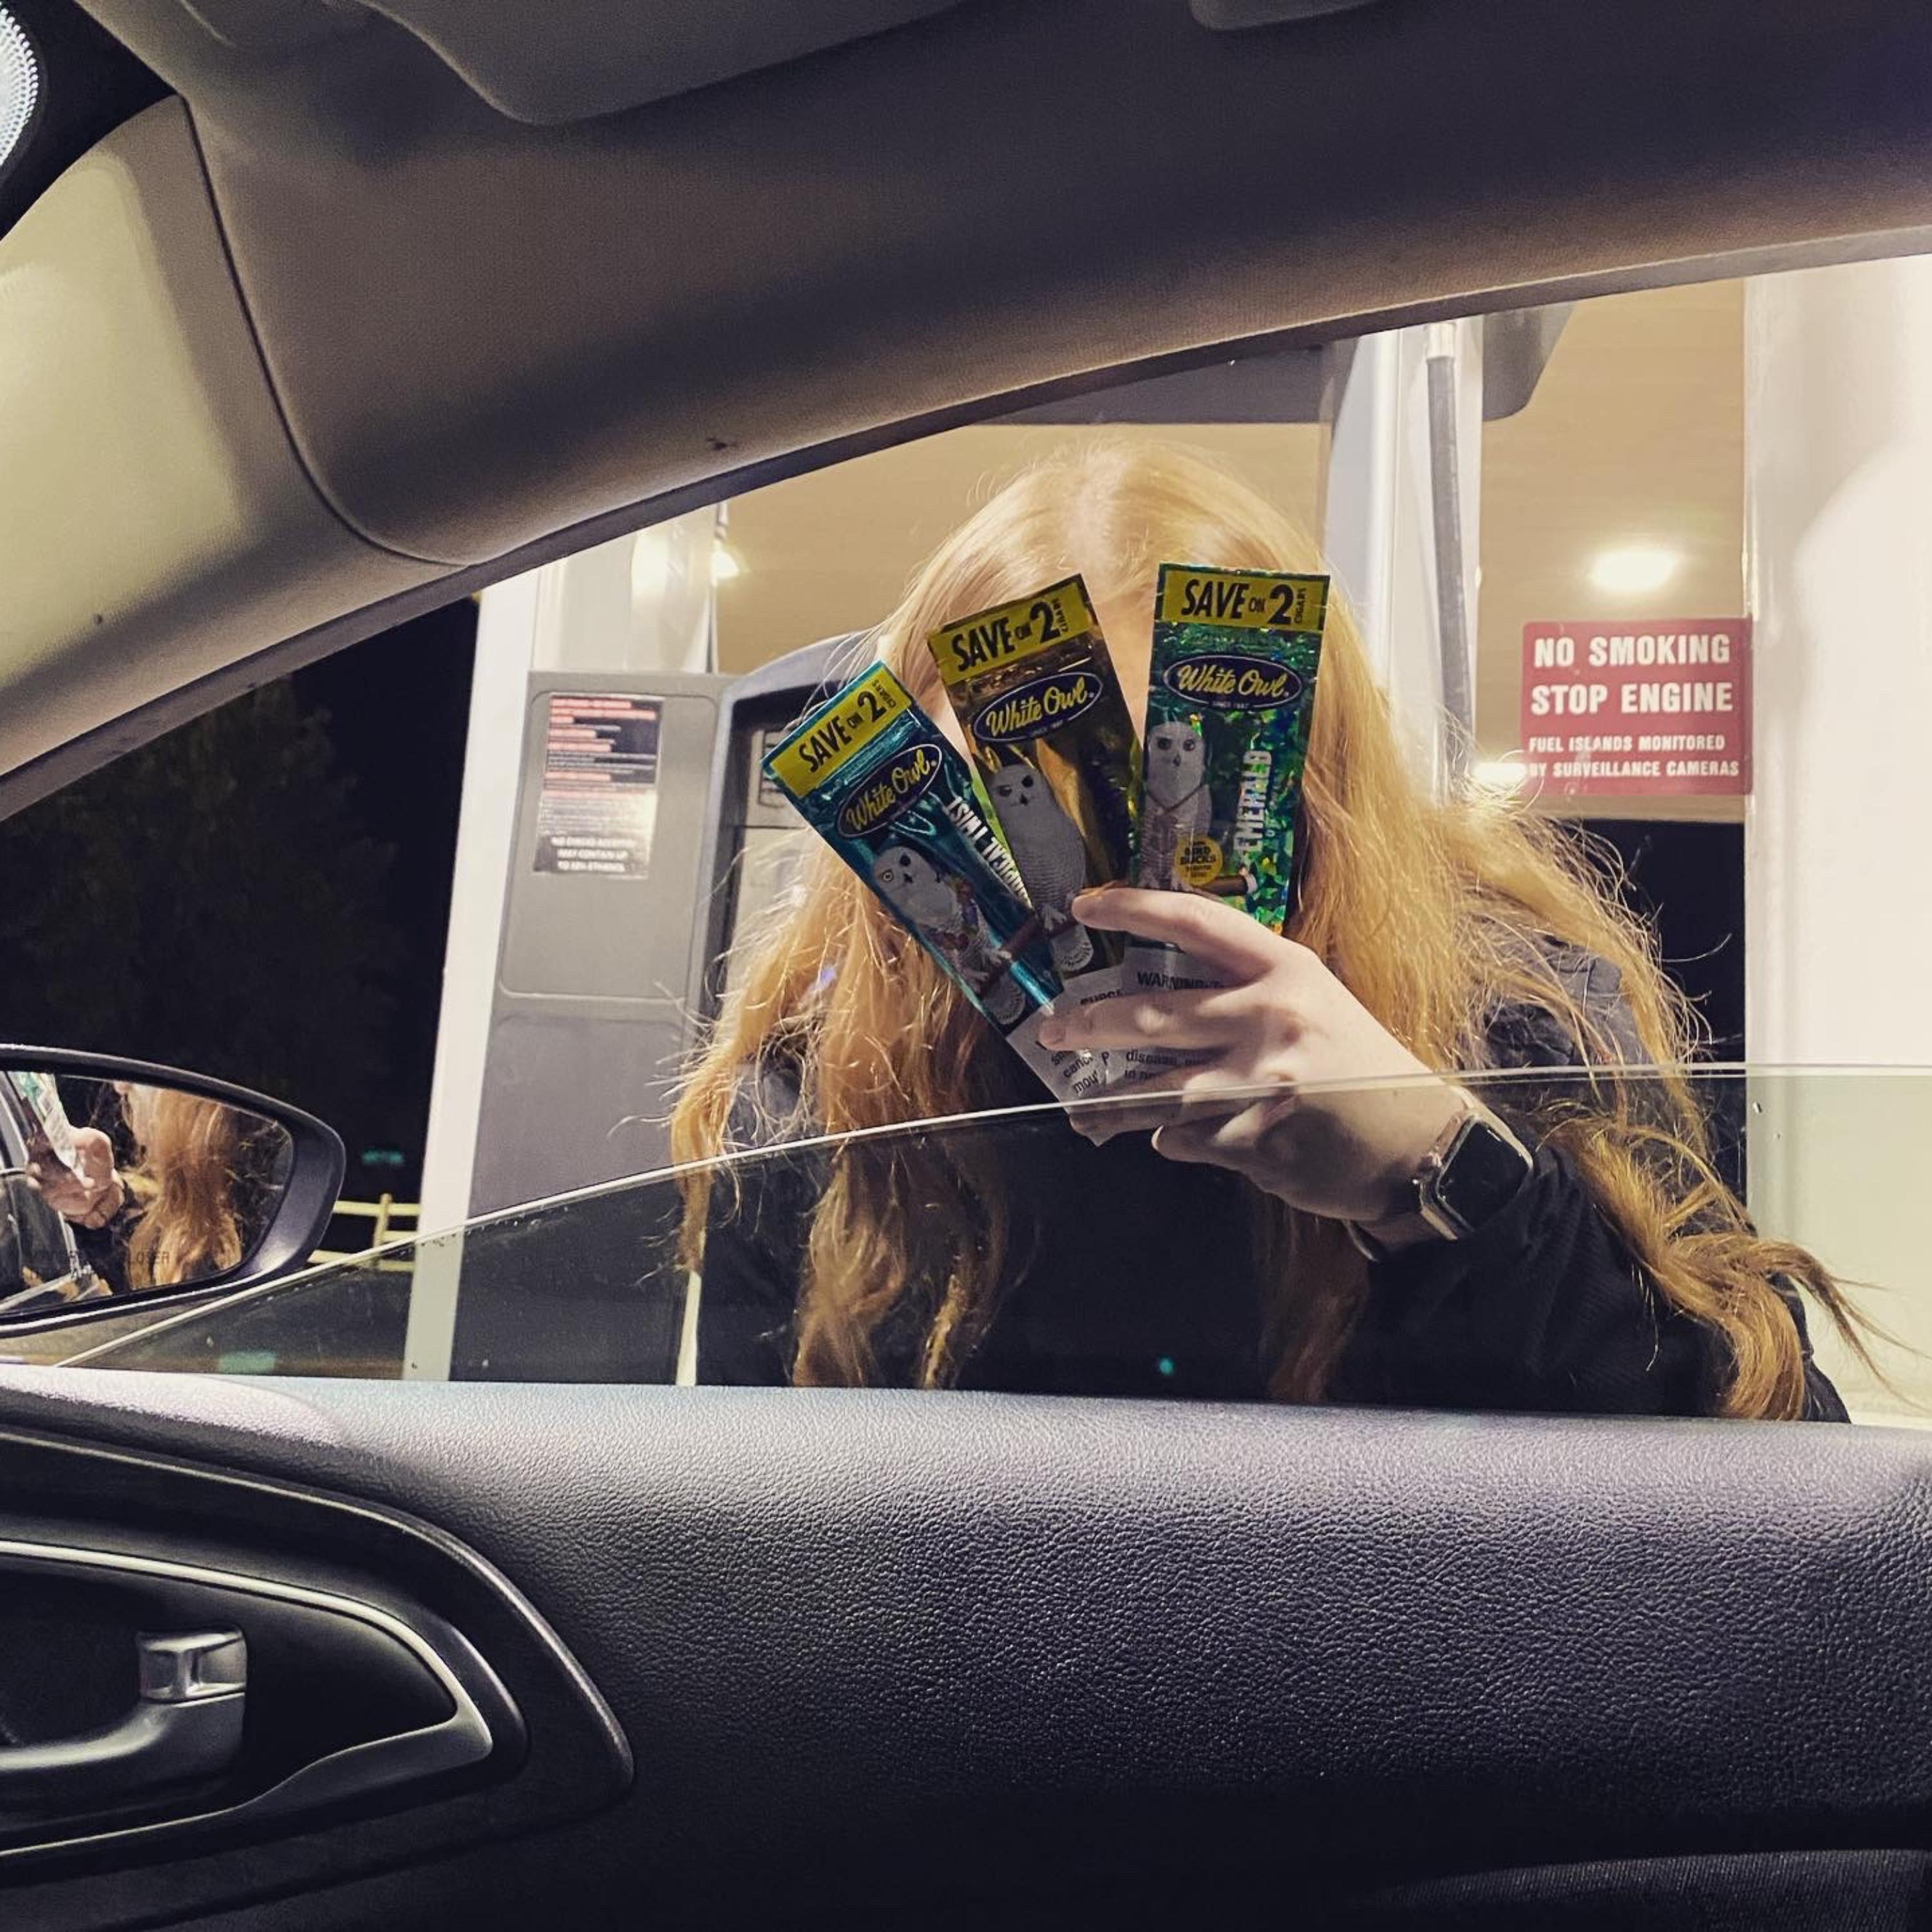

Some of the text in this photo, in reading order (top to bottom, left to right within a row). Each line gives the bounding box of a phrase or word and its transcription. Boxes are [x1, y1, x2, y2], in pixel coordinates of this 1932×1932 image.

[1181, 579, 1294, 625] SAVE ON 2
[952, 601, 1061, 672] SAVE ON 2
[1534, 634, 1730, 667] NO SMOKING
[1177, 664, 1288, 697] White Owl
[1531, 683, 1733, 715] STOP ENGINE
[985, 677, 1088, 737] White Owl
[798, 690, 887, 773] SAVE ON 2
[1529, 735, 1725, 752] FUEL ISLANDS MONITORED
[846, 749, 931, 832] White Owl
[1553, 761, 1661, 778] SURVEILLANCE
[1666, 761, 1739, 777] CAMERAS
[942, 796, 989, 842] TWIST
[1233, 750, 1272, 852] EMERALD
